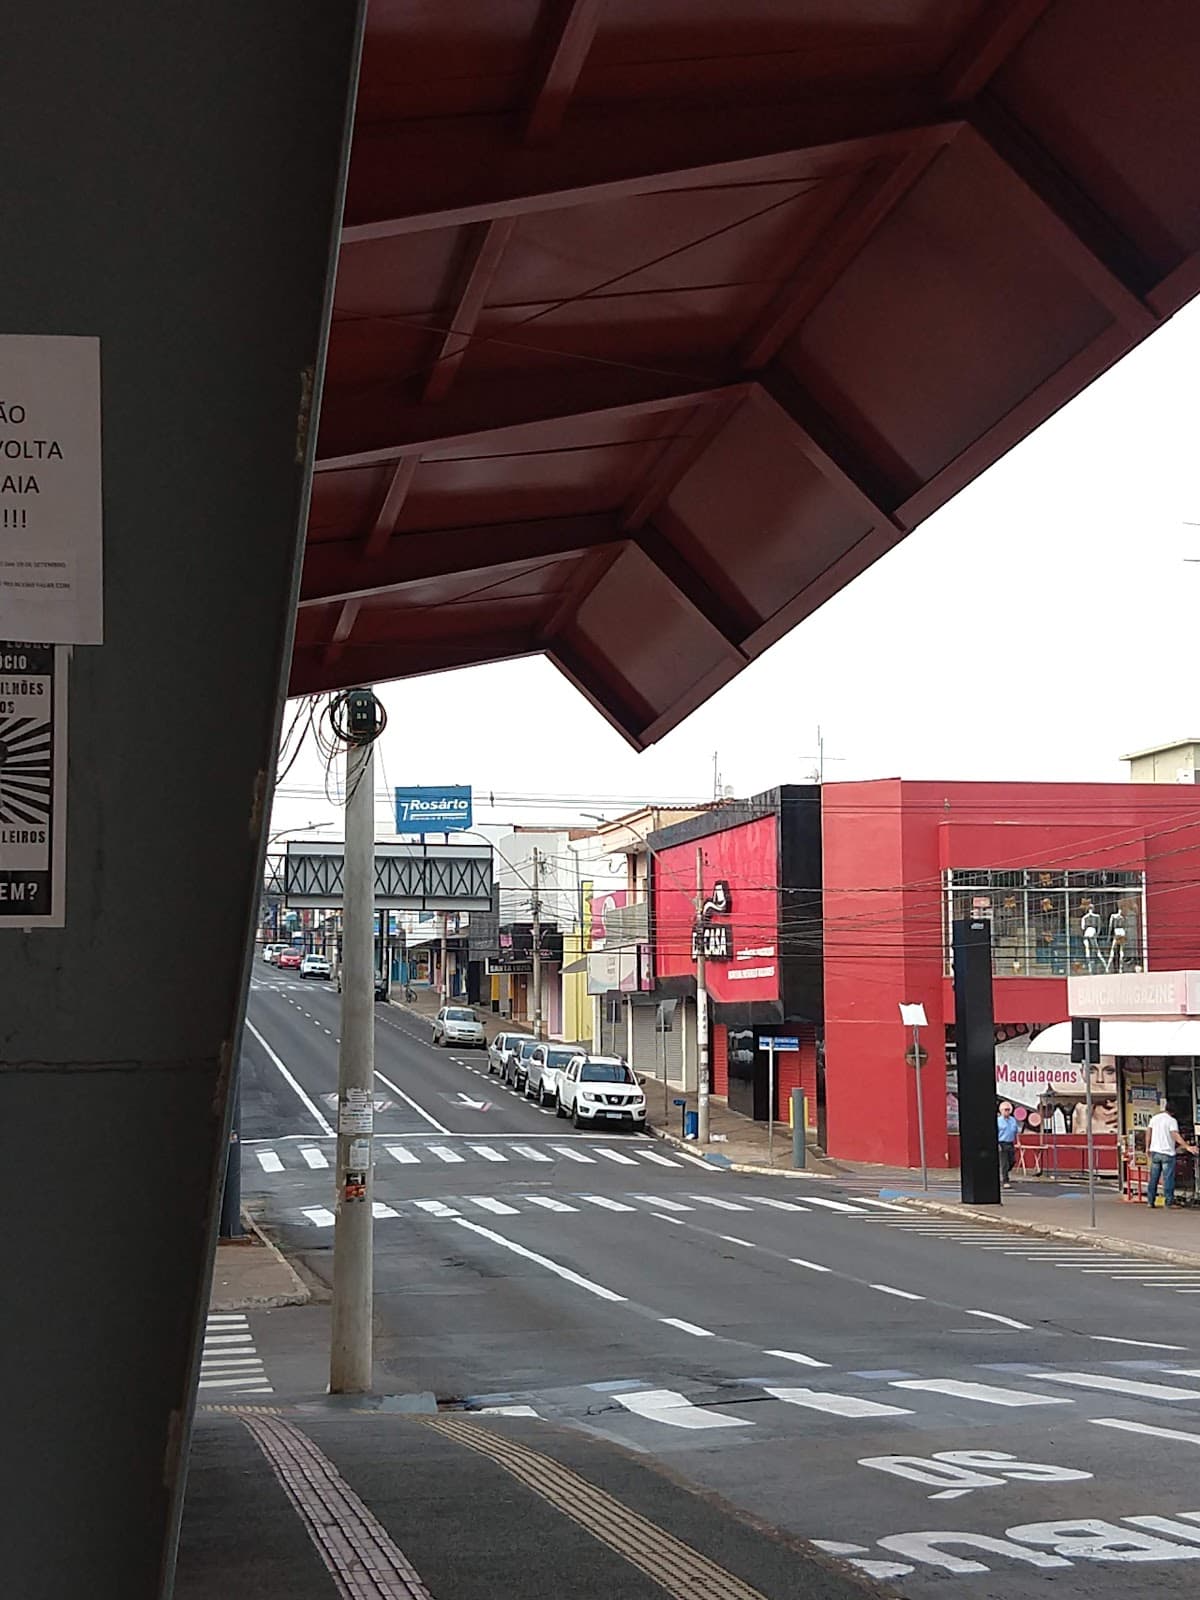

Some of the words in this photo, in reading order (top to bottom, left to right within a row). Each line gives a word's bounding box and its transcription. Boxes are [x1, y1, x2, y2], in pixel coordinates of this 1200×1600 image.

[0, 440, 63, 460] OLTA
[1, 475, 40, 494] AIA
[410, 798, 469, 811] Rosário
[2, 830, 46, 844] LEIROS
